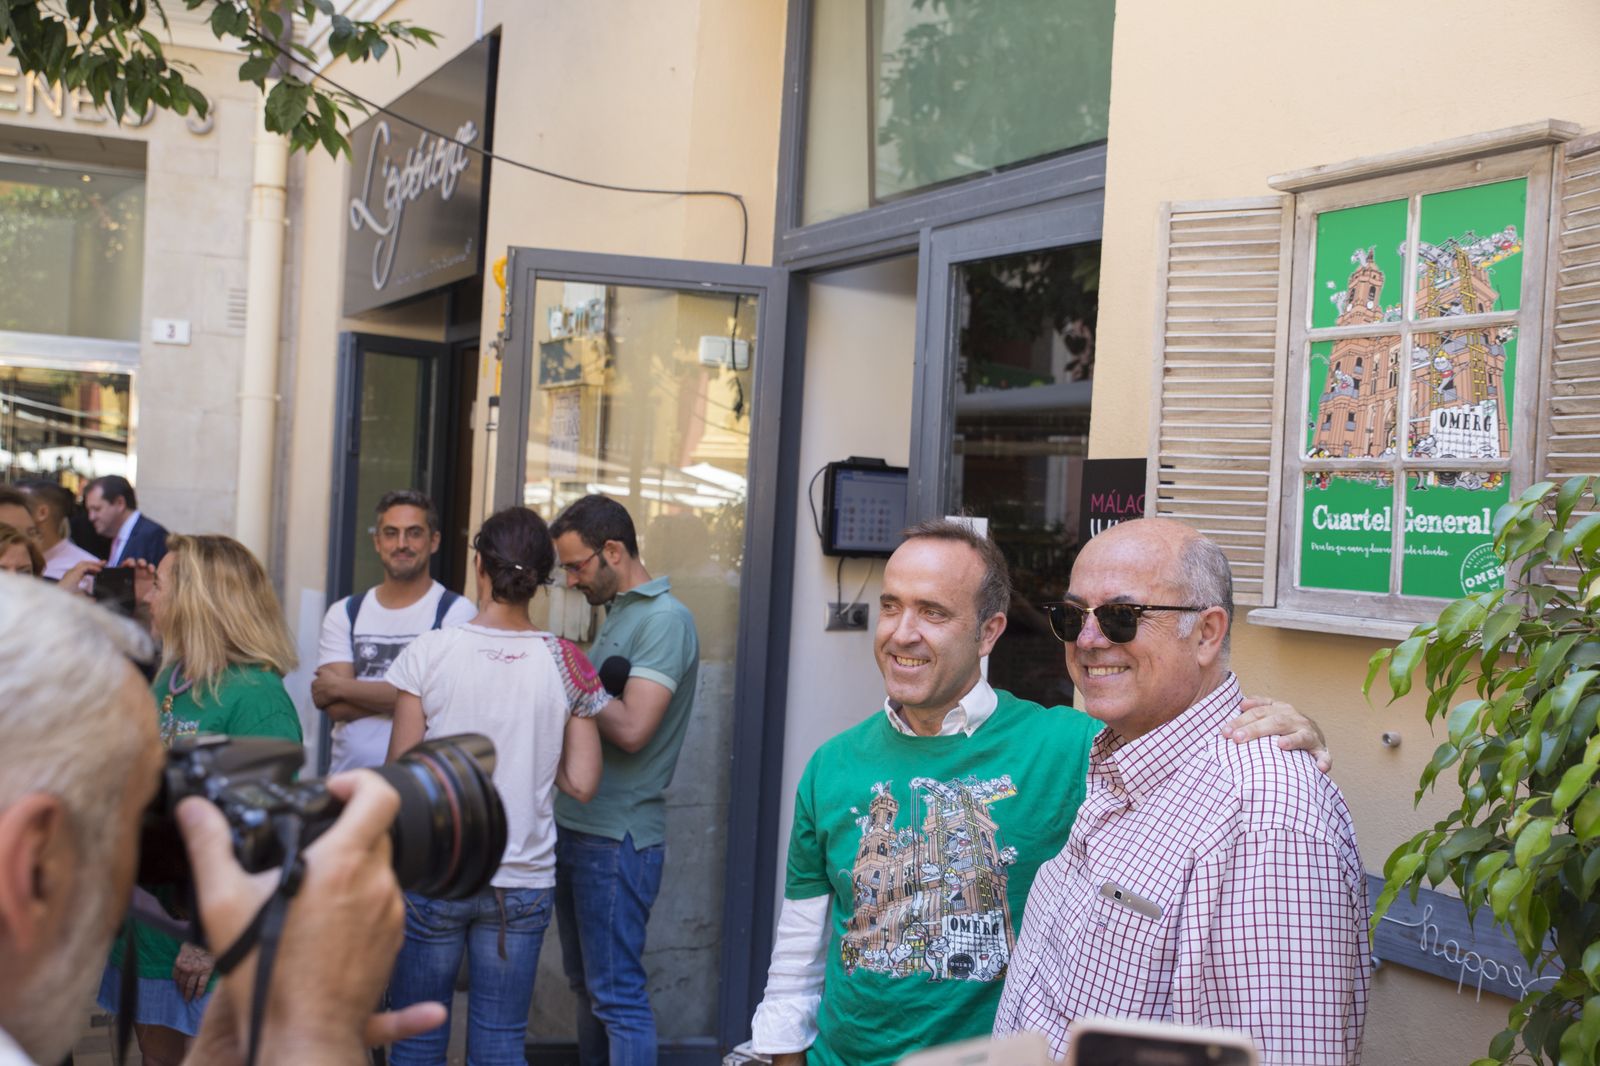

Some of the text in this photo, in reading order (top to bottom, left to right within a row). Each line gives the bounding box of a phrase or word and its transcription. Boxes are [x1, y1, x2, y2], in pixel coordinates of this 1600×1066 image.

[1090, 489, 1145, 513] MÁLA
[1312, 504, 1391, 532] Cuartel
[1464, 565, 1506, 588] OMER
